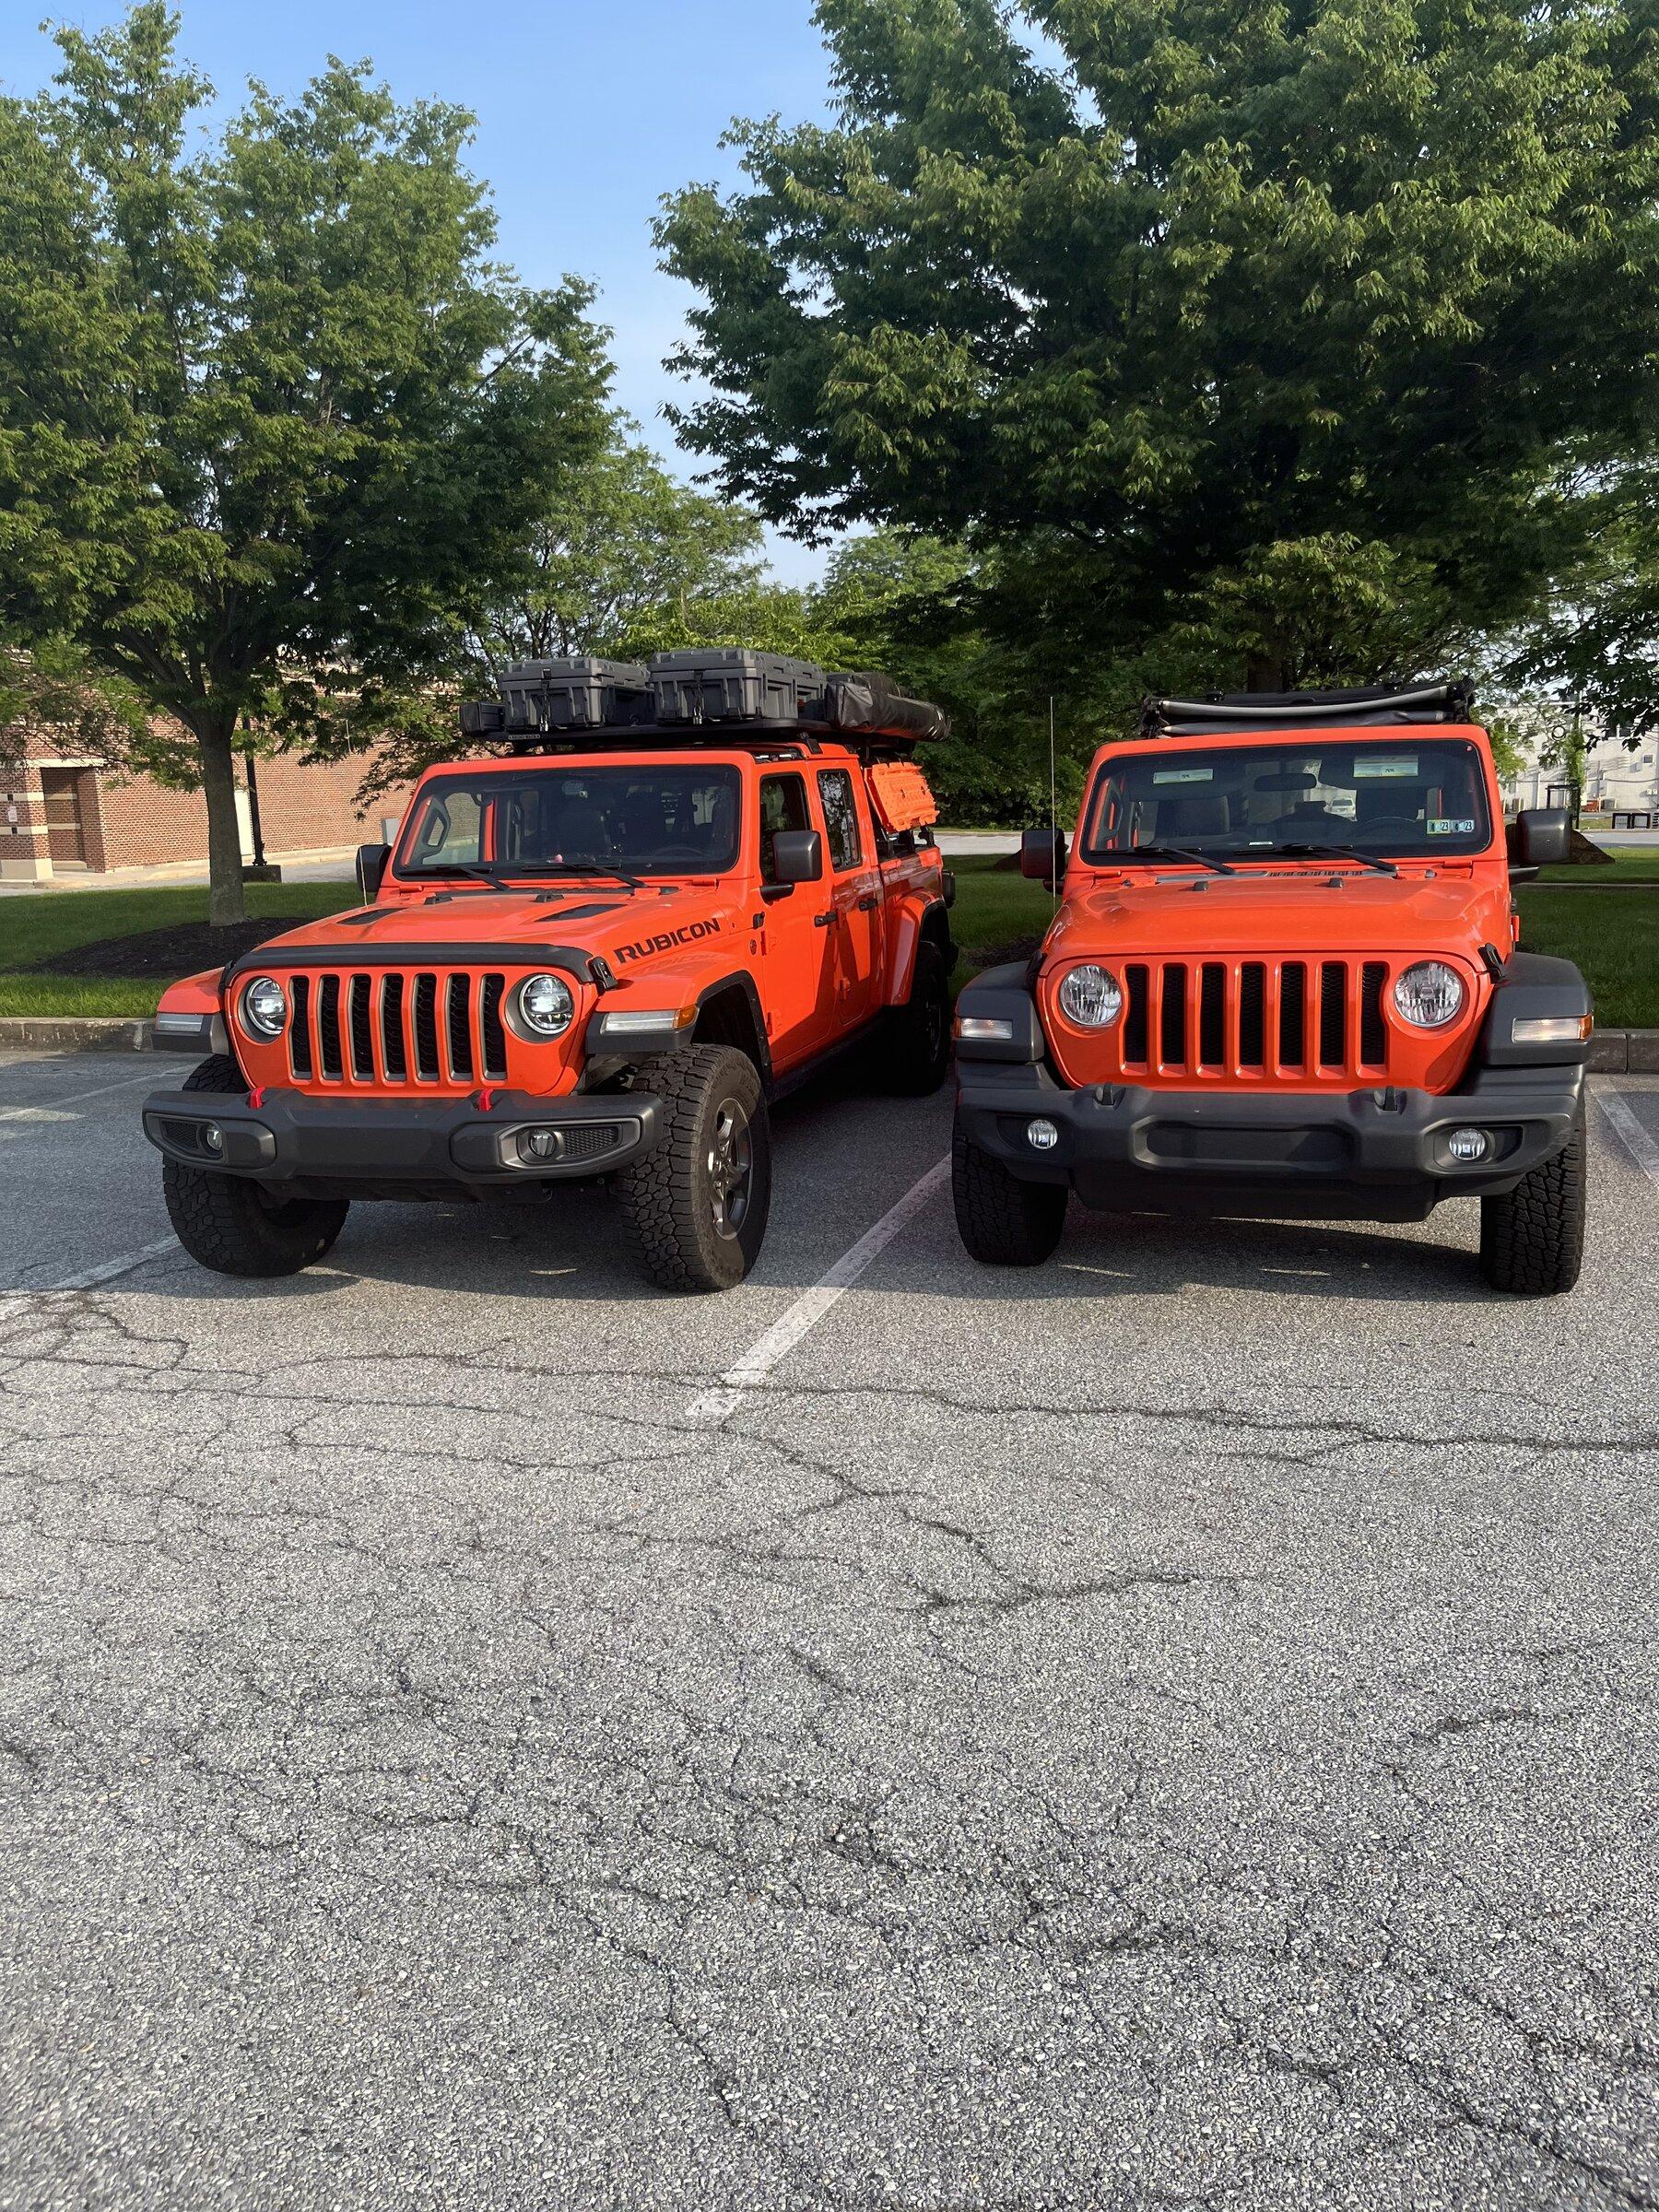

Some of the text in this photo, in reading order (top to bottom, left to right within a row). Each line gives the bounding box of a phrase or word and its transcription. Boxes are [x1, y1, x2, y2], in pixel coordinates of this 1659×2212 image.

[1441, 821, 1449, 831] 23
[1465, 821, 1472, 831] 23
[613, 917, 721, 964] RUBICON
